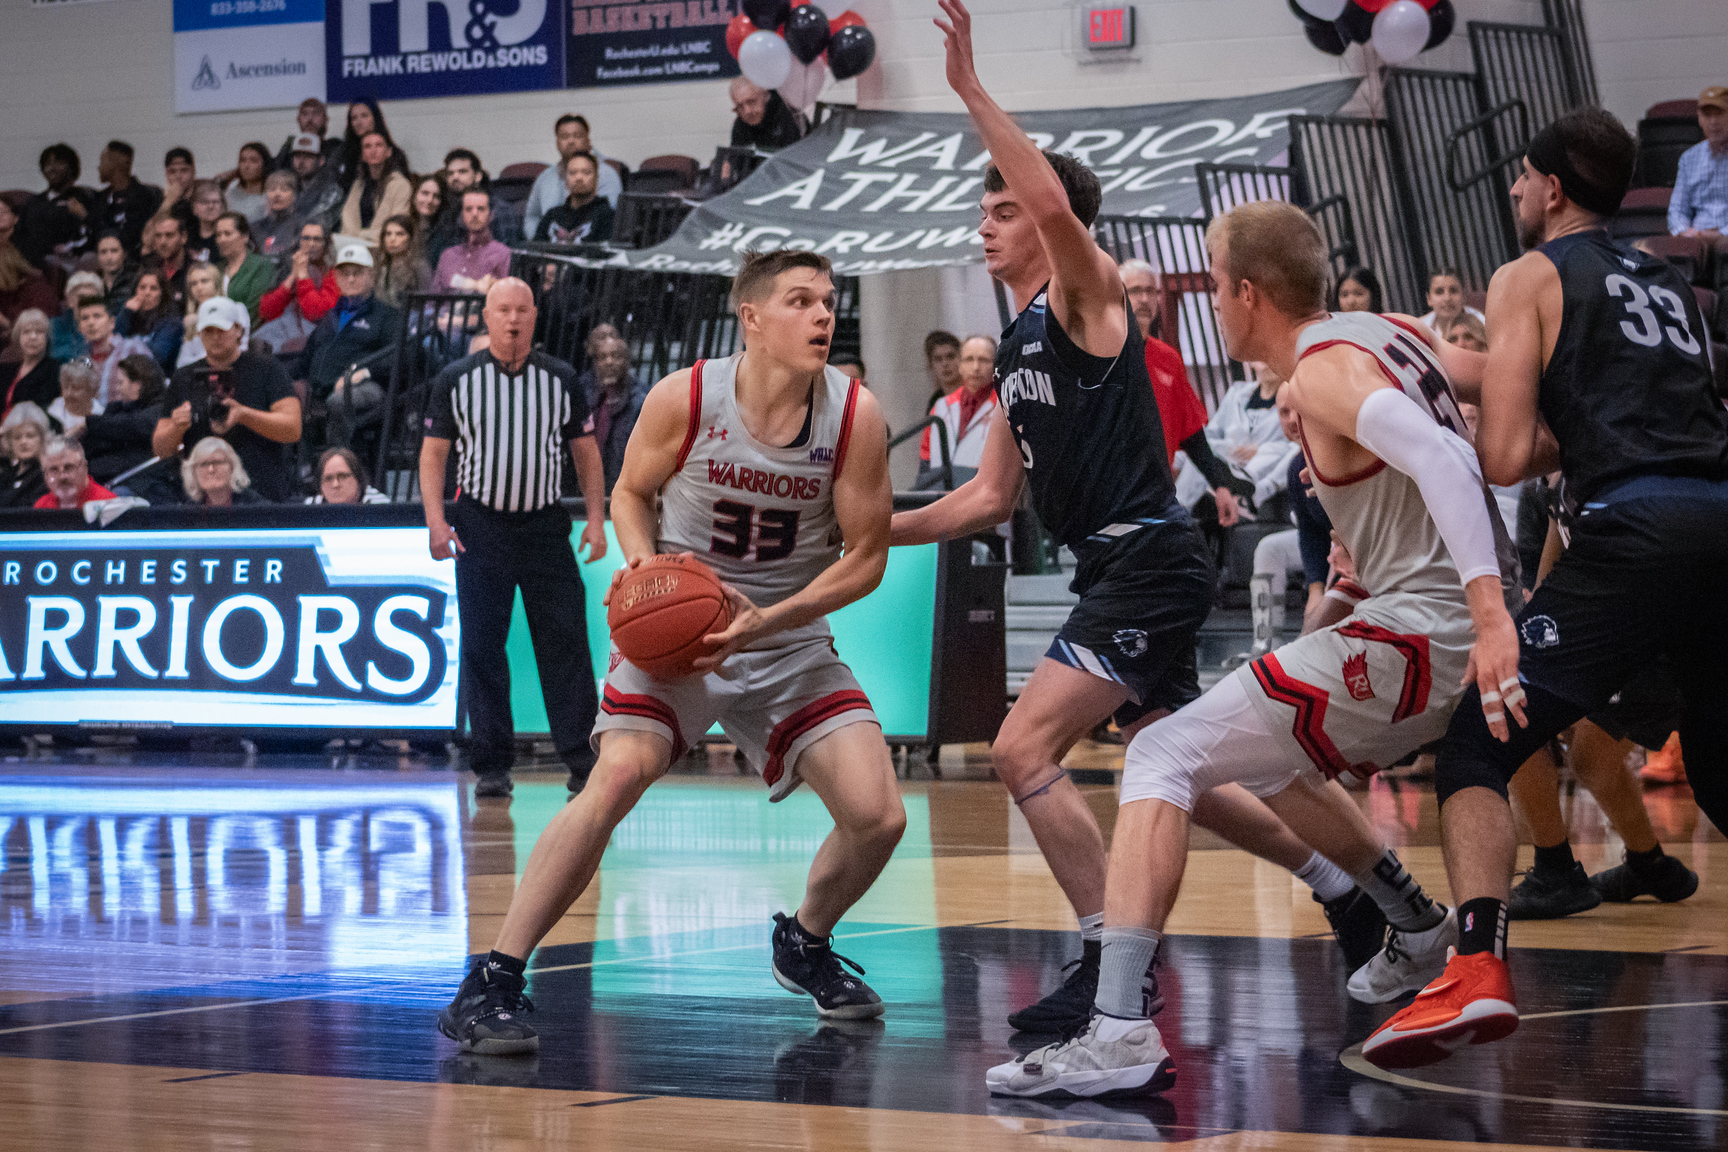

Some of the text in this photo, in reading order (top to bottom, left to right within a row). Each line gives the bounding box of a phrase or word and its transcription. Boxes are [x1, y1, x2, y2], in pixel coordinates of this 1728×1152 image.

[573, 0, 733, 36] BASKETBALL
[1090, 9, 1124, 43] EXIT
[225, 58, 307, 80] Ascension
[342, 56, 403, 78] FRANK
[1605, 273, 1701, 355] 33
[708, 459, 821, 500] WARRIORS
[710, 498, 801, 563] 33
[3, 559, 283, 585] ROCHESTER
[0, 593, 431, 695] RRIORS
